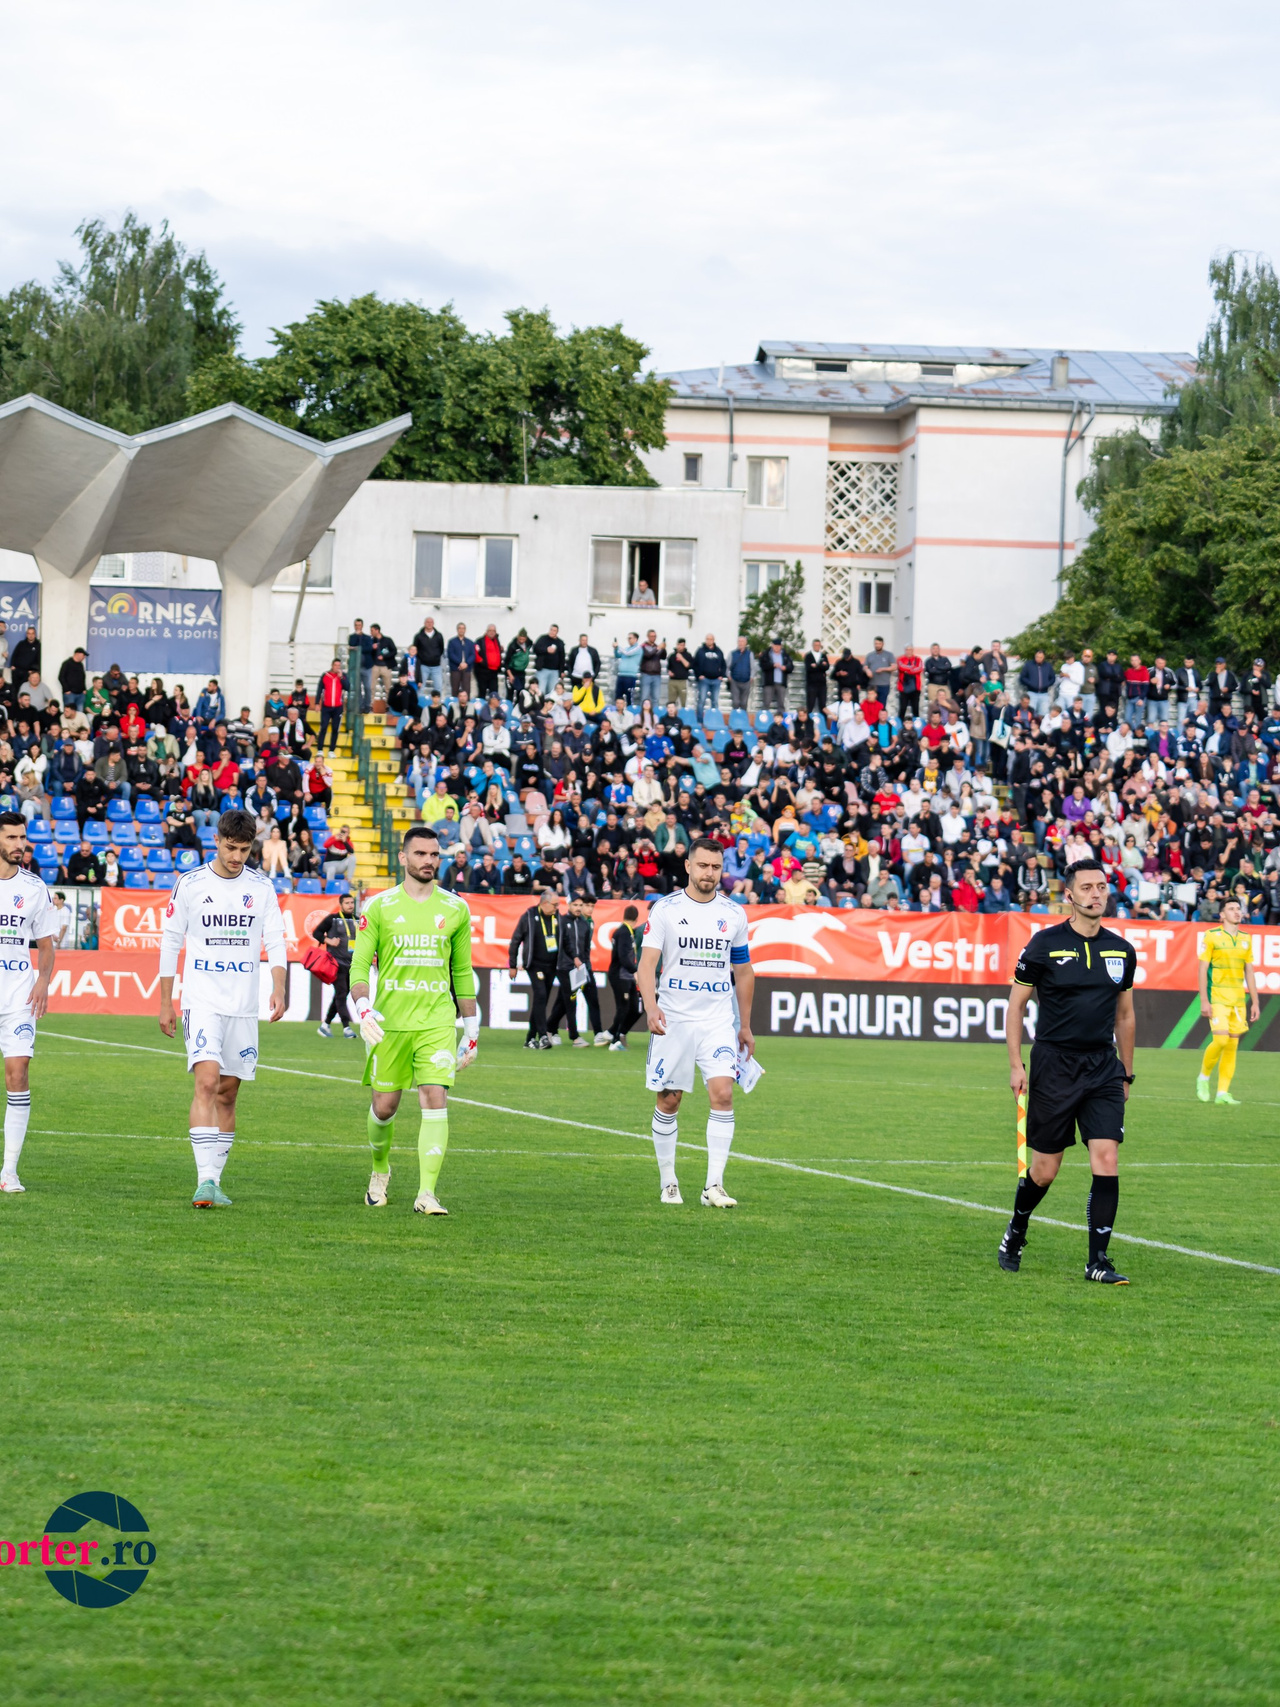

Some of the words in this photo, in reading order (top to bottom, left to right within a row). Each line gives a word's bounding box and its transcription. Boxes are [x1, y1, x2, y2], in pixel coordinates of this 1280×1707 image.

[89, 626, 157, 638] aquapark
[162, 627, 172, 638] &
[177, 628, 218, 640] sports
[201, 914, 256, 927] UNIBET
[114, 937, 137, 948] APA
[393, 934, 448, 949] UNIBET
[678, 937, 731, 951] UNIBET
[877, 931, 1000, 973] Vestra
[48, 970, 161, 999] MATV
[384, 979, 448, 993] ELSACO
[669, 978, 730, 992] ELSACO
[770, 990, 921, 1037] PARIURI
[933, 996, 1039, 1041] SPOR
[195, 1028, 208, 1049] 6
[654, 1058, 665, 1079] 4
